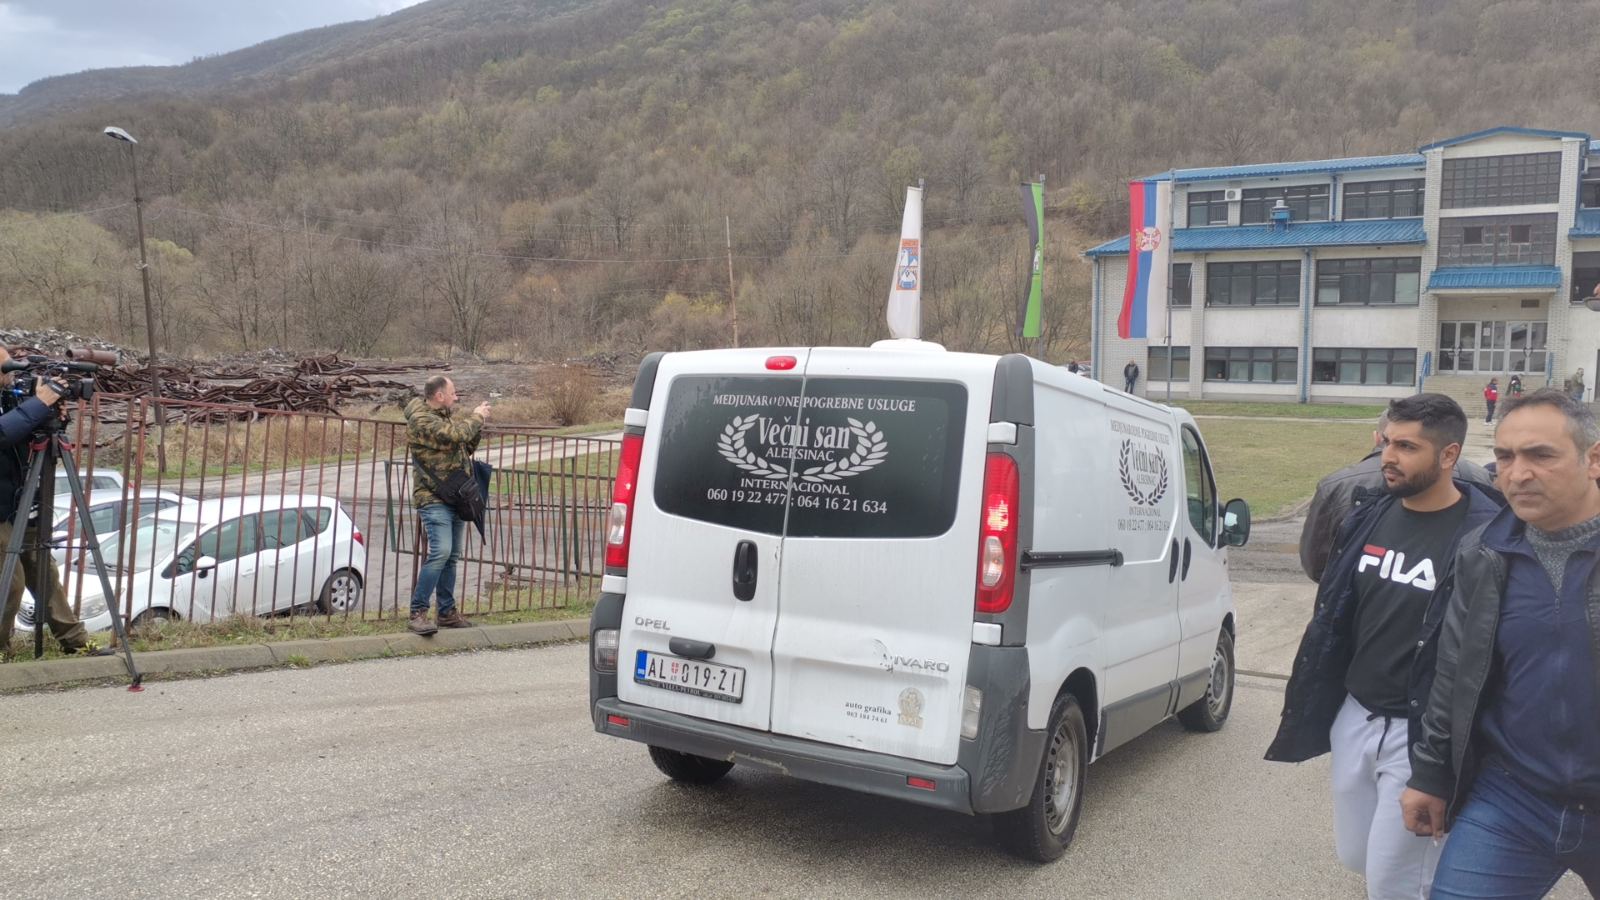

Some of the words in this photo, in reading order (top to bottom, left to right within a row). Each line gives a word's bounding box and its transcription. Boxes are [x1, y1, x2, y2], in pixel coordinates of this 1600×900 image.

[713, 393, 800, 409] MEDJUNARODNE
[803, 396, 865, 411] POGREBNE
[867, 398, 916, 412] USLUGE
[758, 415, 809, 448] Večni
[813, 423, 851, 449] san
[765, 446, 835, 462] ALEKSINAC
[740, 477, 850, 496] INTERNACIONAL
[707, 487, 728, 501] 060
[732, 489, 745, 502] 19
[747, 490, 762, 503] 22
[797, 494, 820, 509] 064
[825, 496, 839, 510] 16
[842, 498, 858, 512] 21
[862, 500, 887, 514] 634
[1358, 544, 1437, 591] FILA
[635, 616, 671, 630] OPEL
[648, 658, 666, 679] AL
[882, 653, 950, 673] IVARO
[845, 701, 862, 710] auto
[864, 703, 892, 716] grafika
